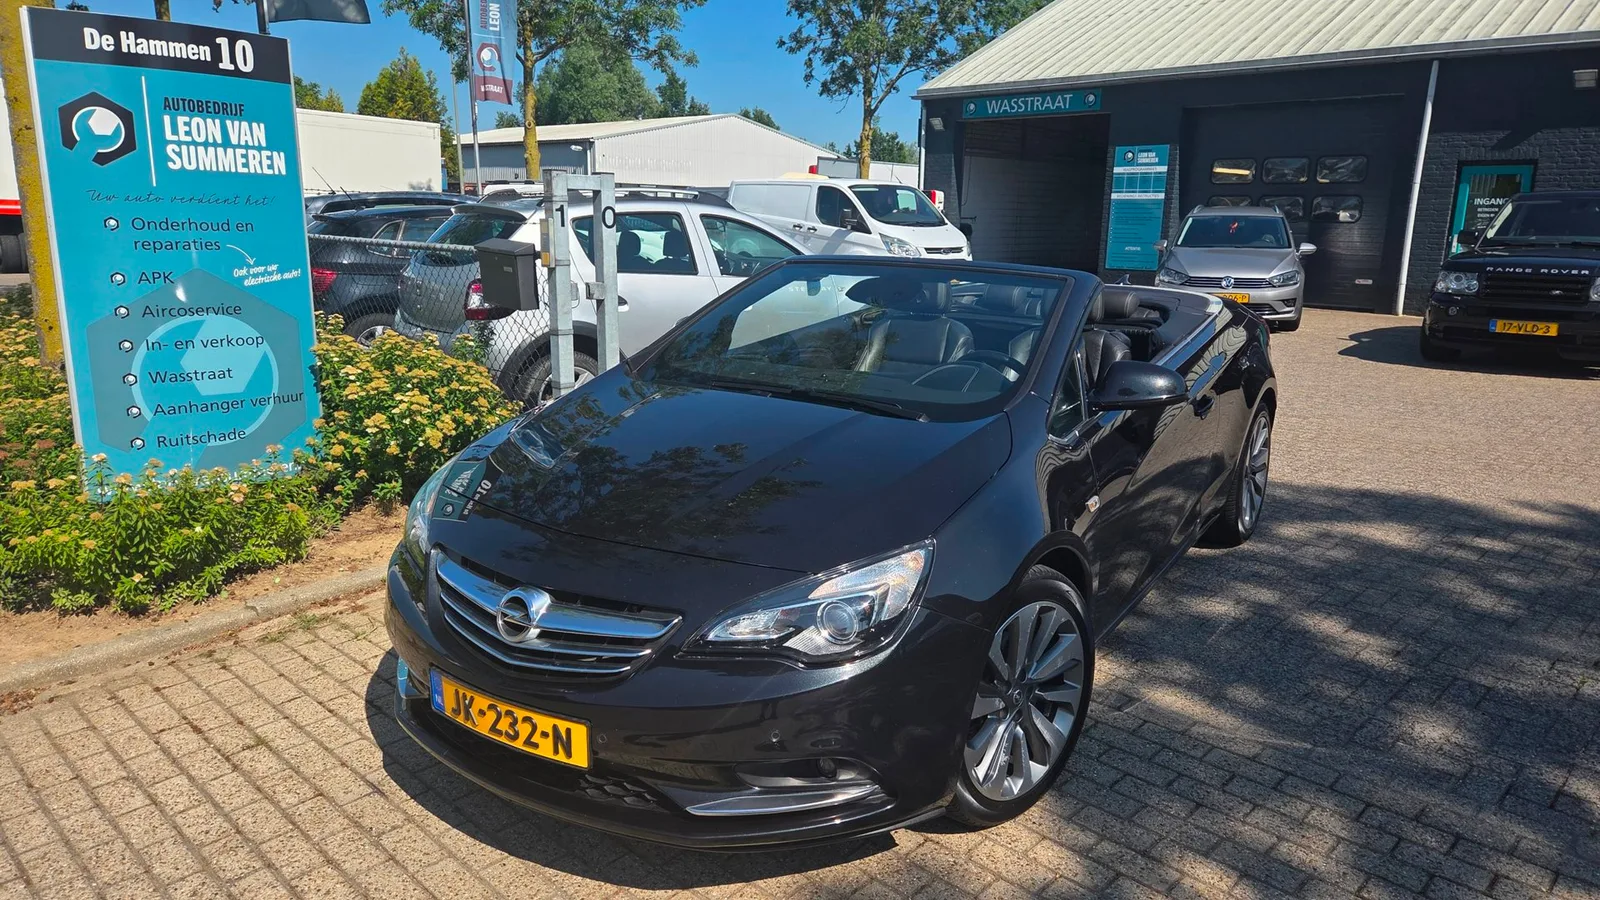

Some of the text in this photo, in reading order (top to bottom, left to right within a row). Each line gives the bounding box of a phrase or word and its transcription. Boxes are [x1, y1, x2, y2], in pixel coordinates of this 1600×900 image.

[489, 3, 500, 31] LEON
[83, 27, 255, 73] De Hammen 10
[163, 96, 245, 117] AUTOBEDRIJF
[986, 93, 1074, 115] WASSTRAAT
[163, 114, 267, 149] LEON VAN
[165, 144, 287, 176] SUMMEREN
[86, 189, 276, 206] Uw auto verdient het!
[131, 217, 255, 233] Onderhoud en
[133, 237, 222, 254] reparaties
[137, 271, 175, 285] APK
[233, 264, 280, 278] Ook voor uw
[244, 268, 301, 286] electrische auto!
[141, 303, 243, 318] Aircoservice
[1502, 322, 1551, 334] 17-VLD-3
[145, 334, 266, 352] In- en verkoop
[148, 367, 234, 384] Wasstraat
[152, 390, 305, 418] Aanhanger verhuur
[156, 428, 247, 448] Ruitschade
[451, 688, 573, 760] JK-232-N
